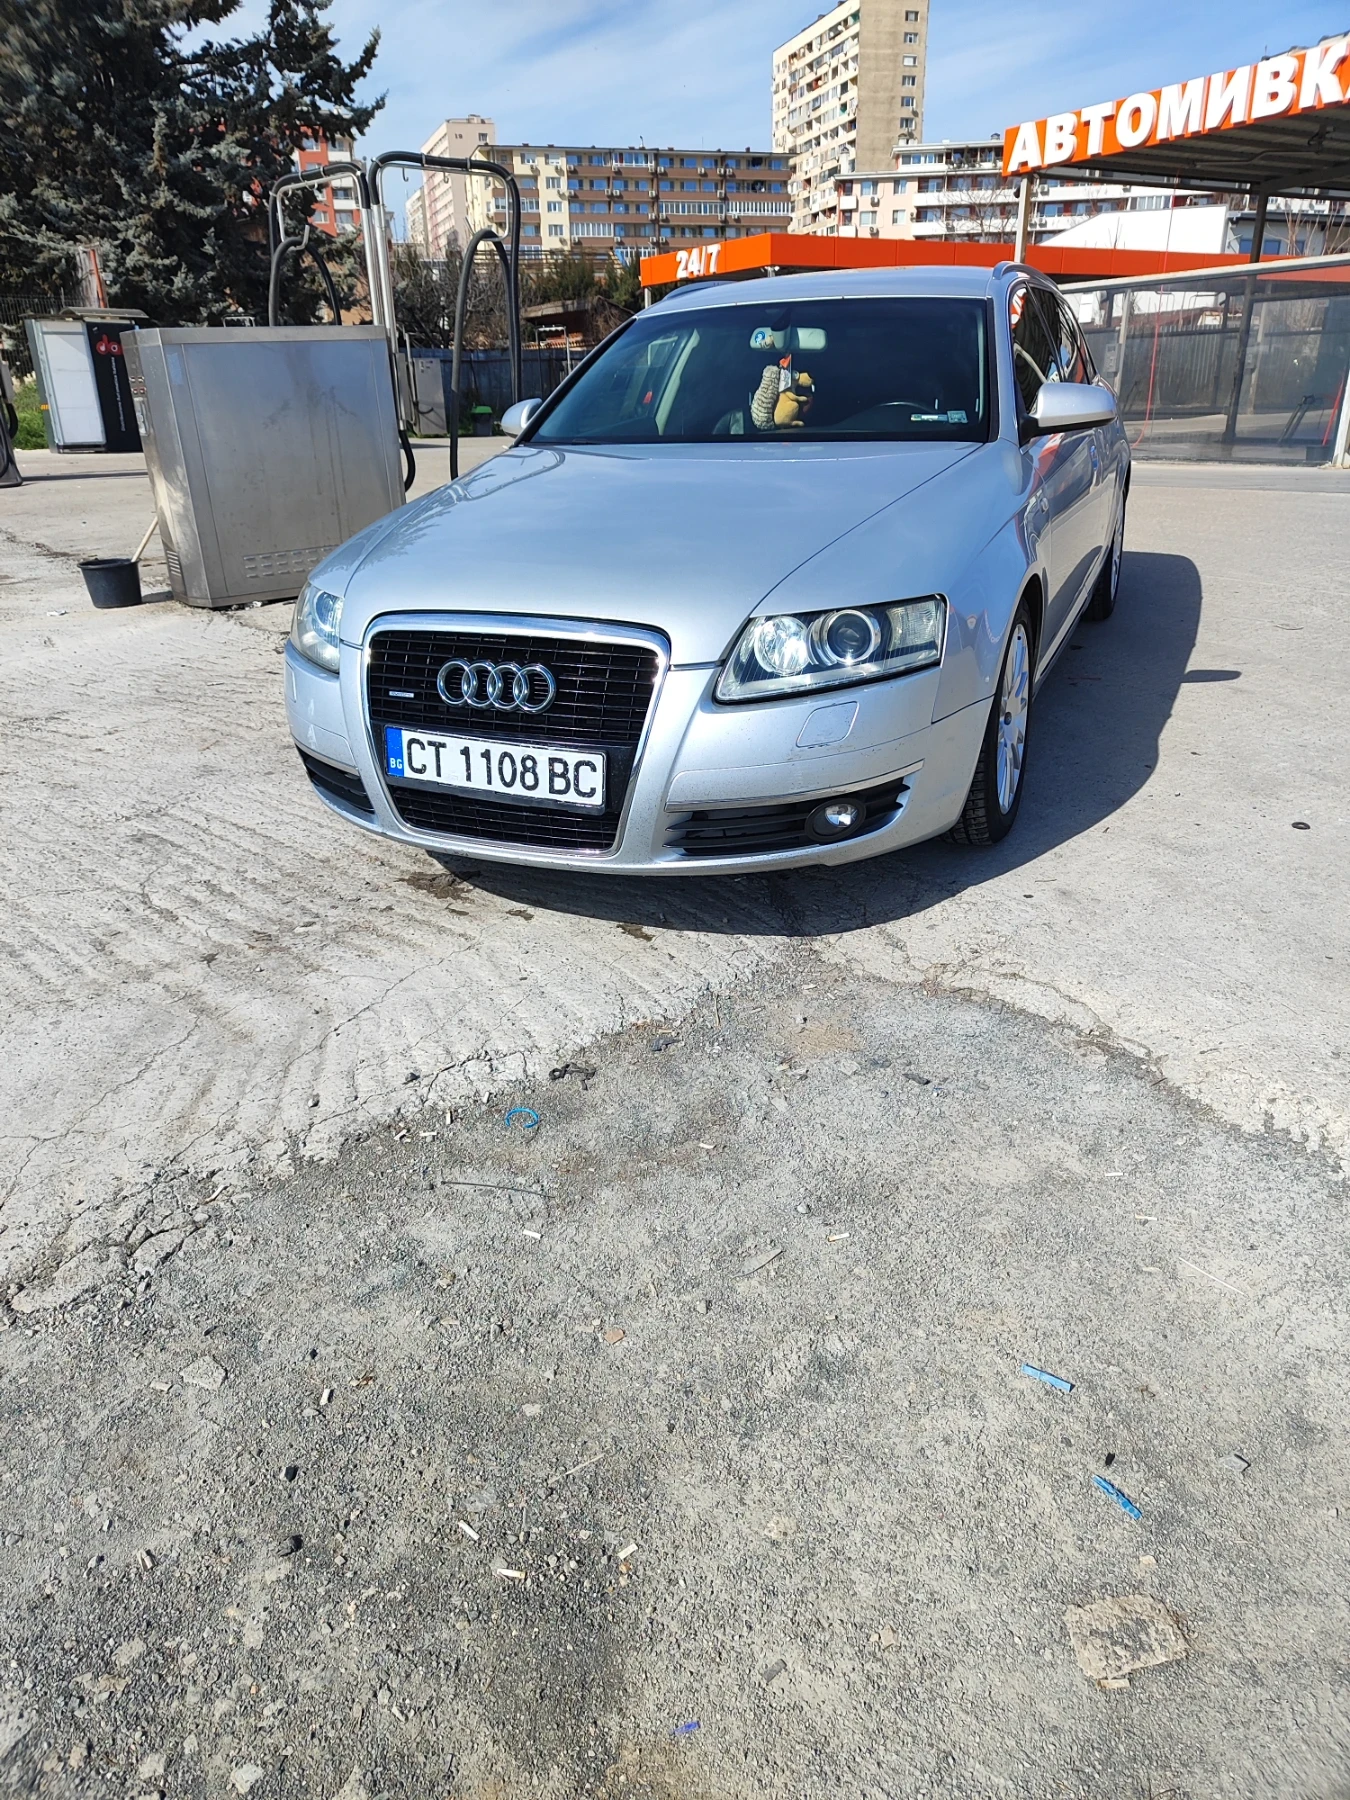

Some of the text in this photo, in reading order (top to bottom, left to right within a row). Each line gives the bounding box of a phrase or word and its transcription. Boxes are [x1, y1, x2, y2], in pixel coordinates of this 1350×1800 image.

[1007, 41, 1350, 172] АВТОМИВК
[676, 243, 721, 279] 24/7
[390, 757, 403, 769] BG
[407, 738, 597, 798] CT 1108 BC
